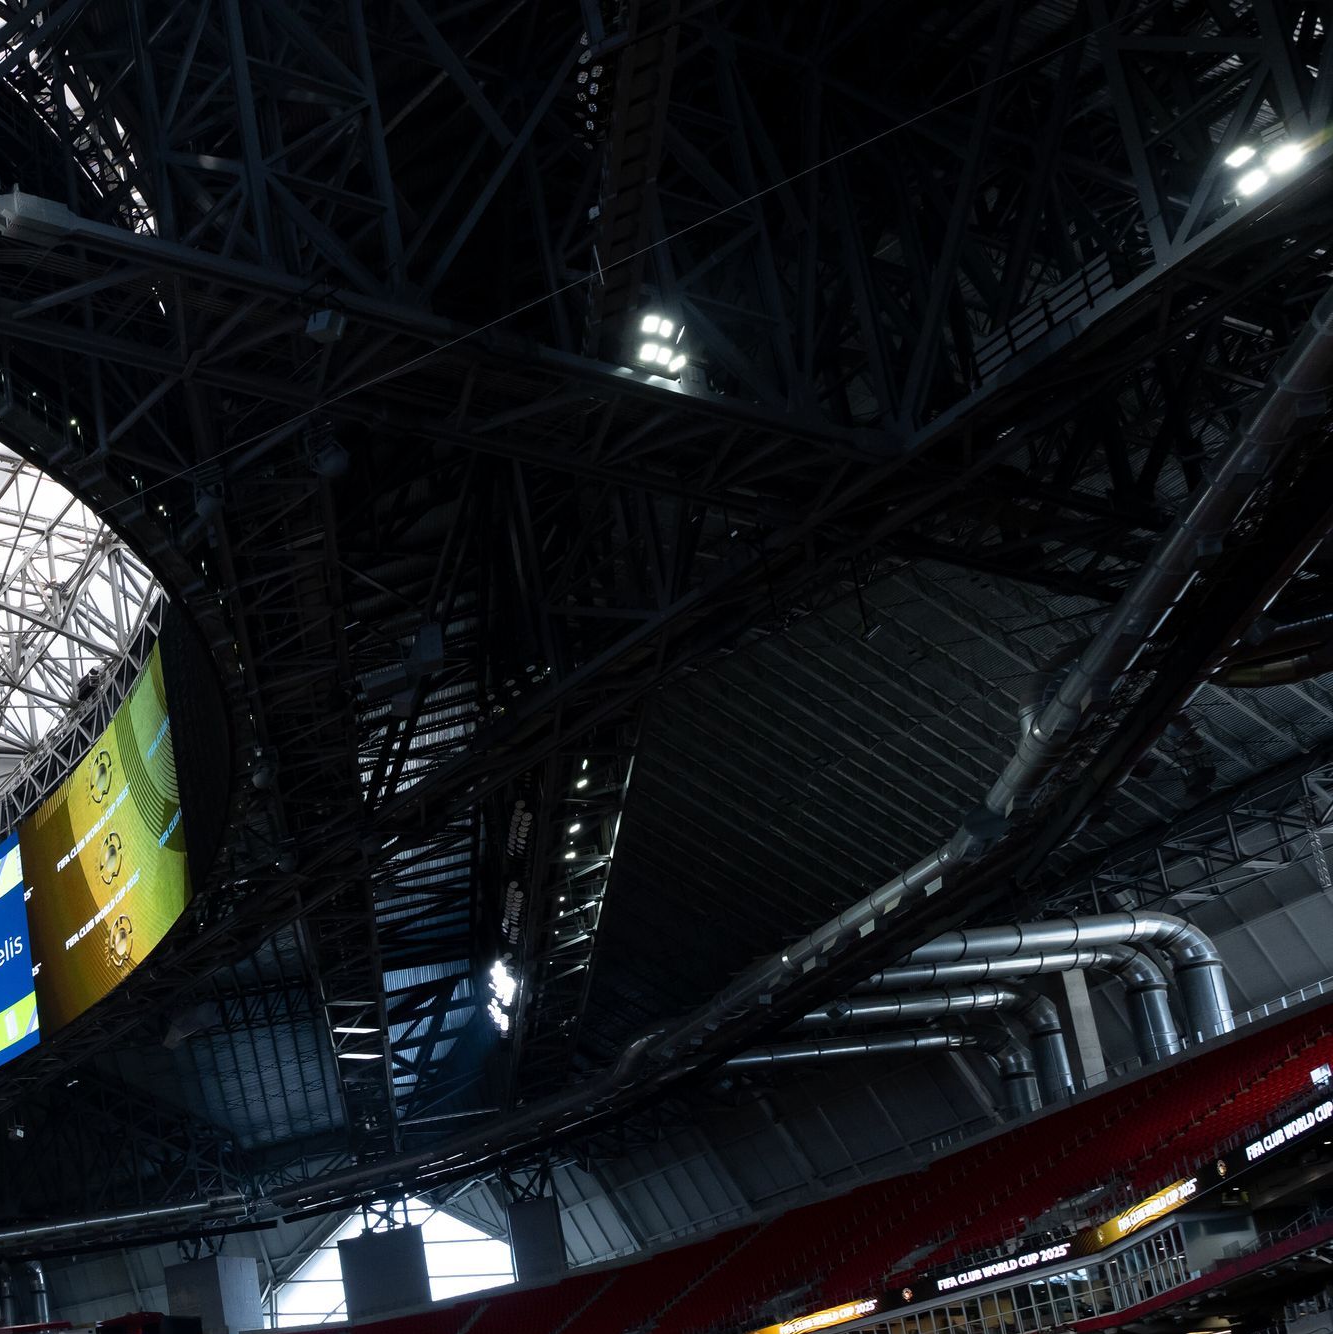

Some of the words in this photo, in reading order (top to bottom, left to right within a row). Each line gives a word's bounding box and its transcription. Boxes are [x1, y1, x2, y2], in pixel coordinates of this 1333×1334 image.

[66, 932, 79, 950] FIFA
[79, 916, 95, 938] CLUB
[95, 899, 114, 924] WORLD
[113, 887, 127, 906] CUP
[1247, 1141, 1264, 1161] FIFA
[1263, 1128, 1285, 1151] CLUB
[1283, 1110, 1314, 1141] WORLD
[938, 1276, 958, 1290] FIFA
[959, 1268, 983, 1285] CLUB
[983, 1259, 1018, 1278] WORLD
[1019, 1252, 1039, 1268] CUP
